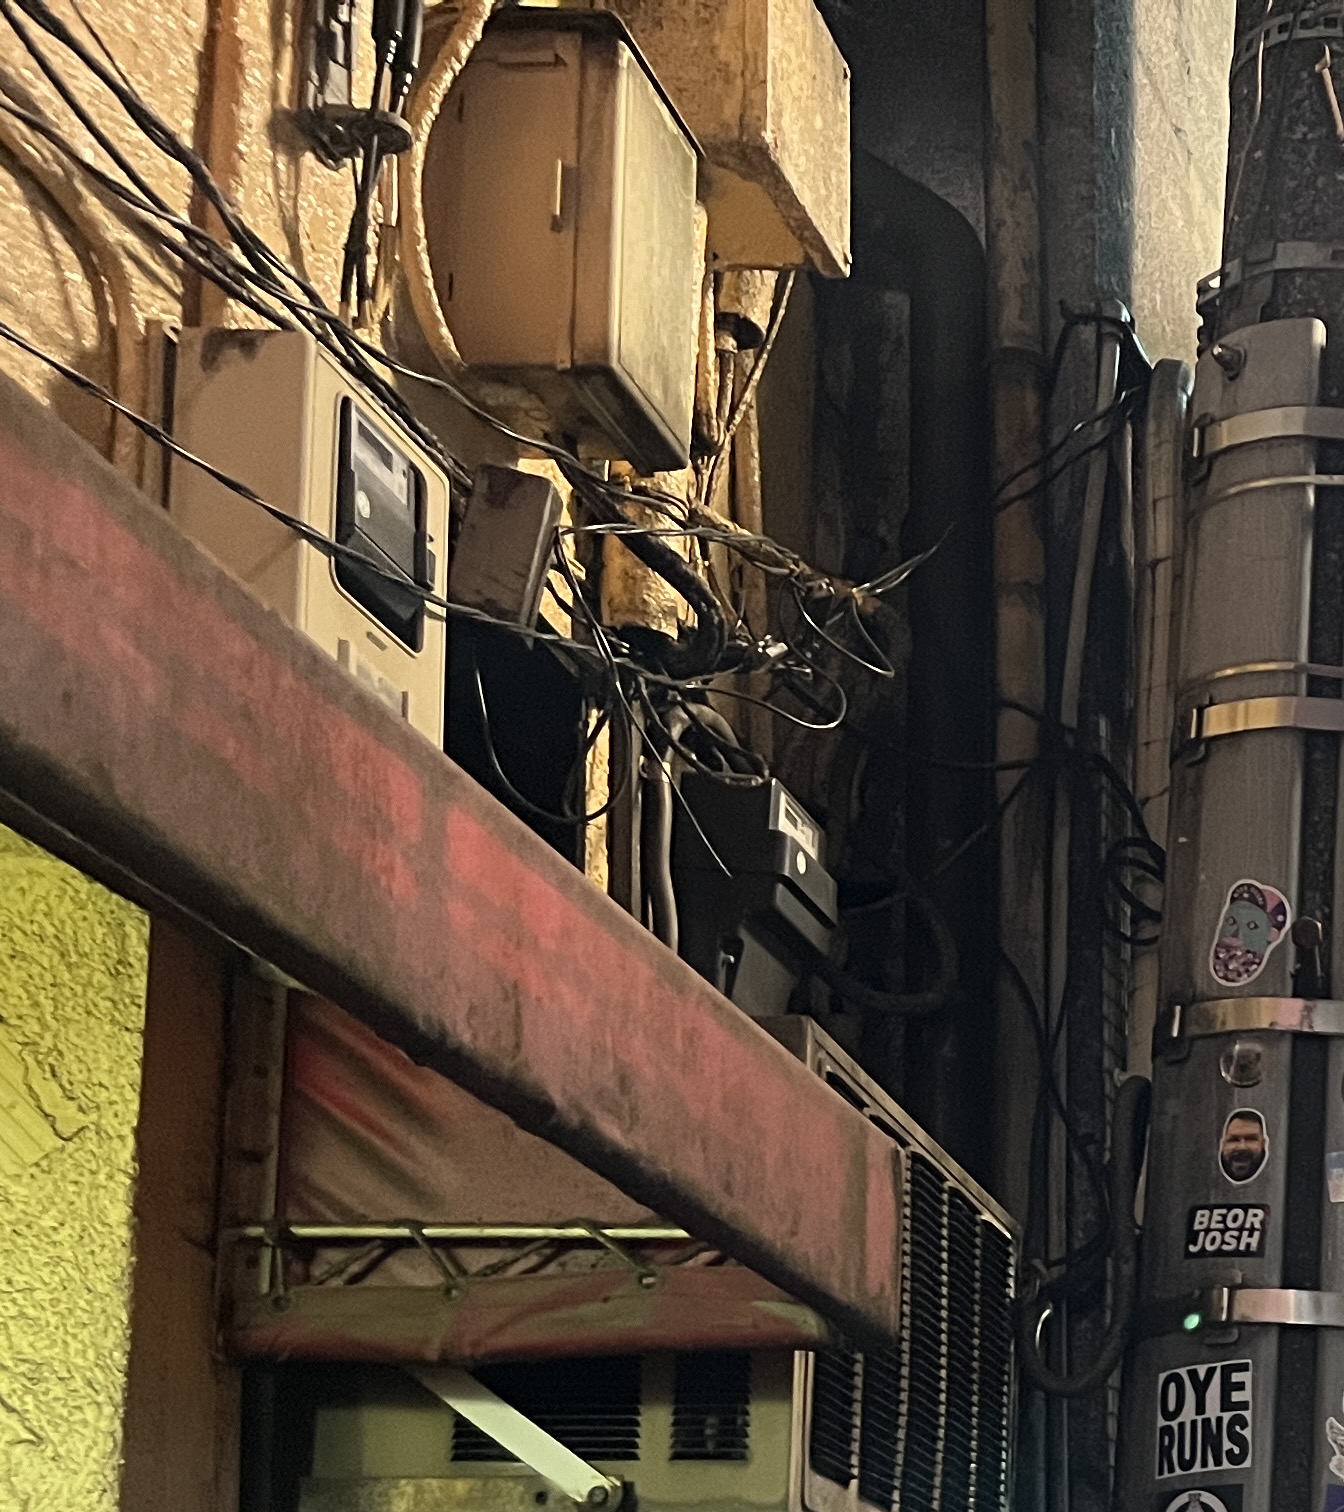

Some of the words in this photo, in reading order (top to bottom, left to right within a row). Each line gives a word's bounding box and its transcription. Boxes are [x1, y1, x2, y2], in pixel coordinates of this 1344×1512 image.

[1188, 1228, 1261, 1252] JOSH
[1193, 1208, 1265, 1230] BEOR
[1159, 1362, 1251, 1422] OYE
[1157, 1413, 1251, 1477] RUNS
